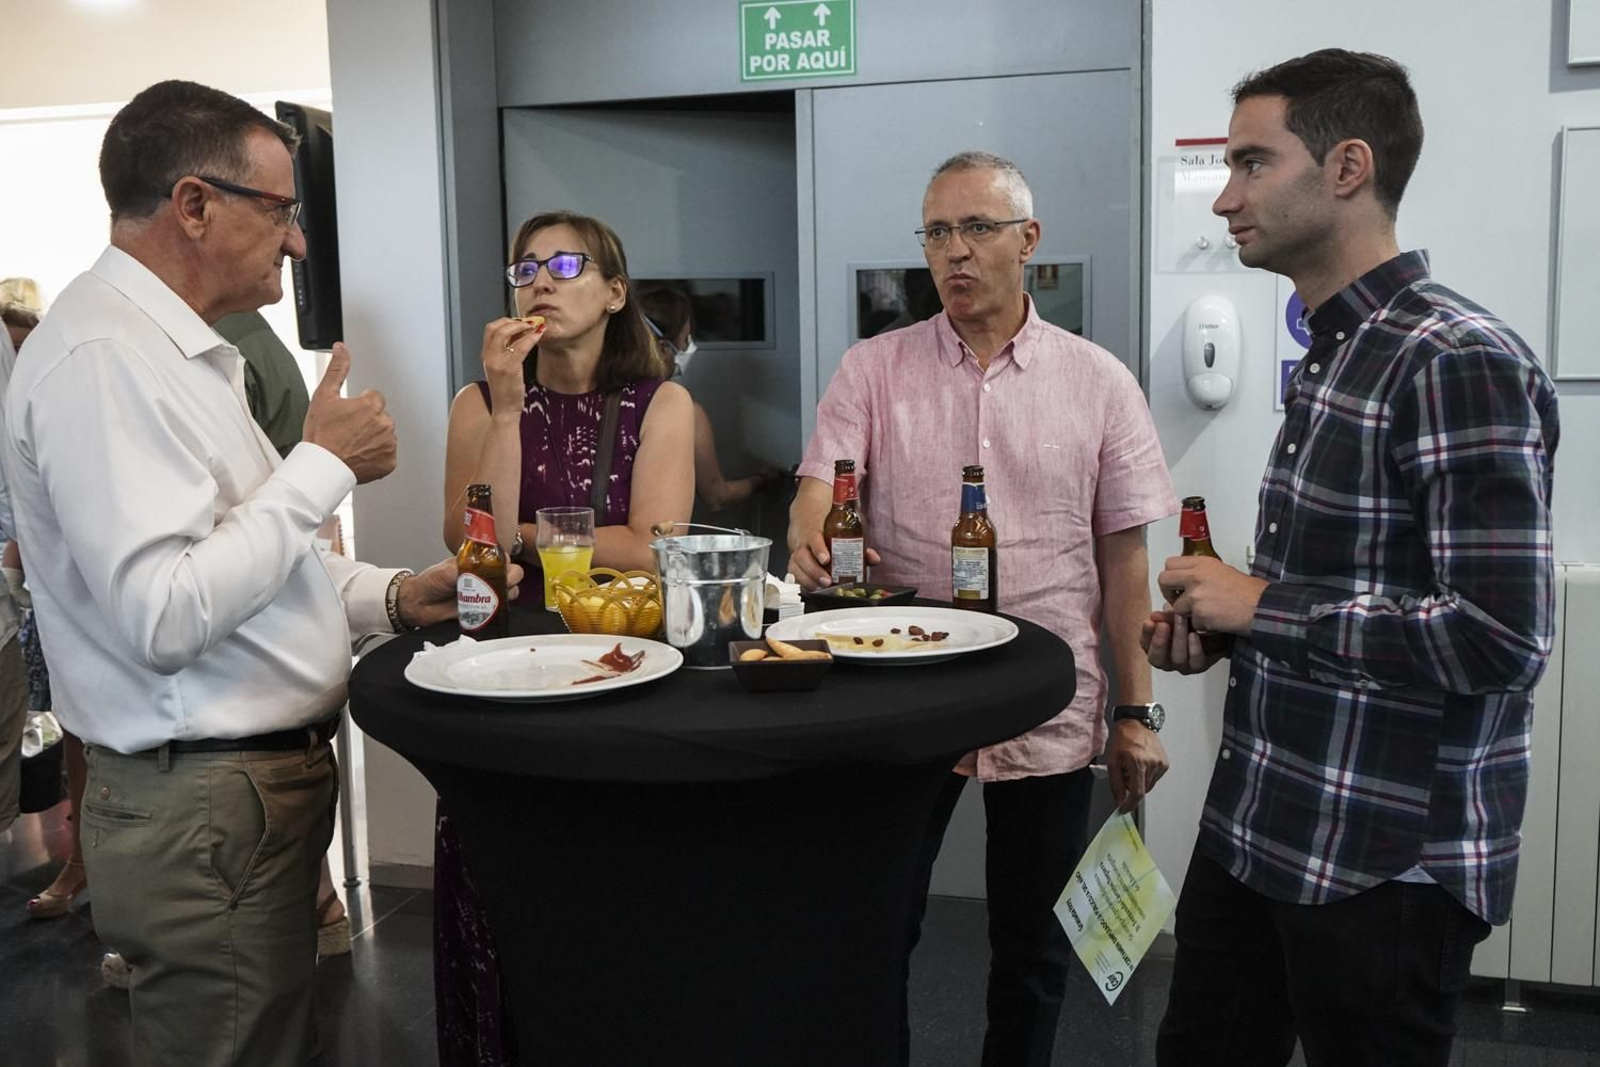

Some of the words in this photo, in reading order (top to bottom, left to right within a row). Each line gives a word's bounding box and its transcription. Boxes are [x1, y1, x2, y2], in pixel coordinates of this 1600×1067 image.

[765, 29, 831, 50] PASAR
[750, 53, 790, 73] POR
[796, 45, 846, 70] AQUÍ
[1181, 154, 1205, 165] Sala
[1209, 154, 1224, 165] Jo
